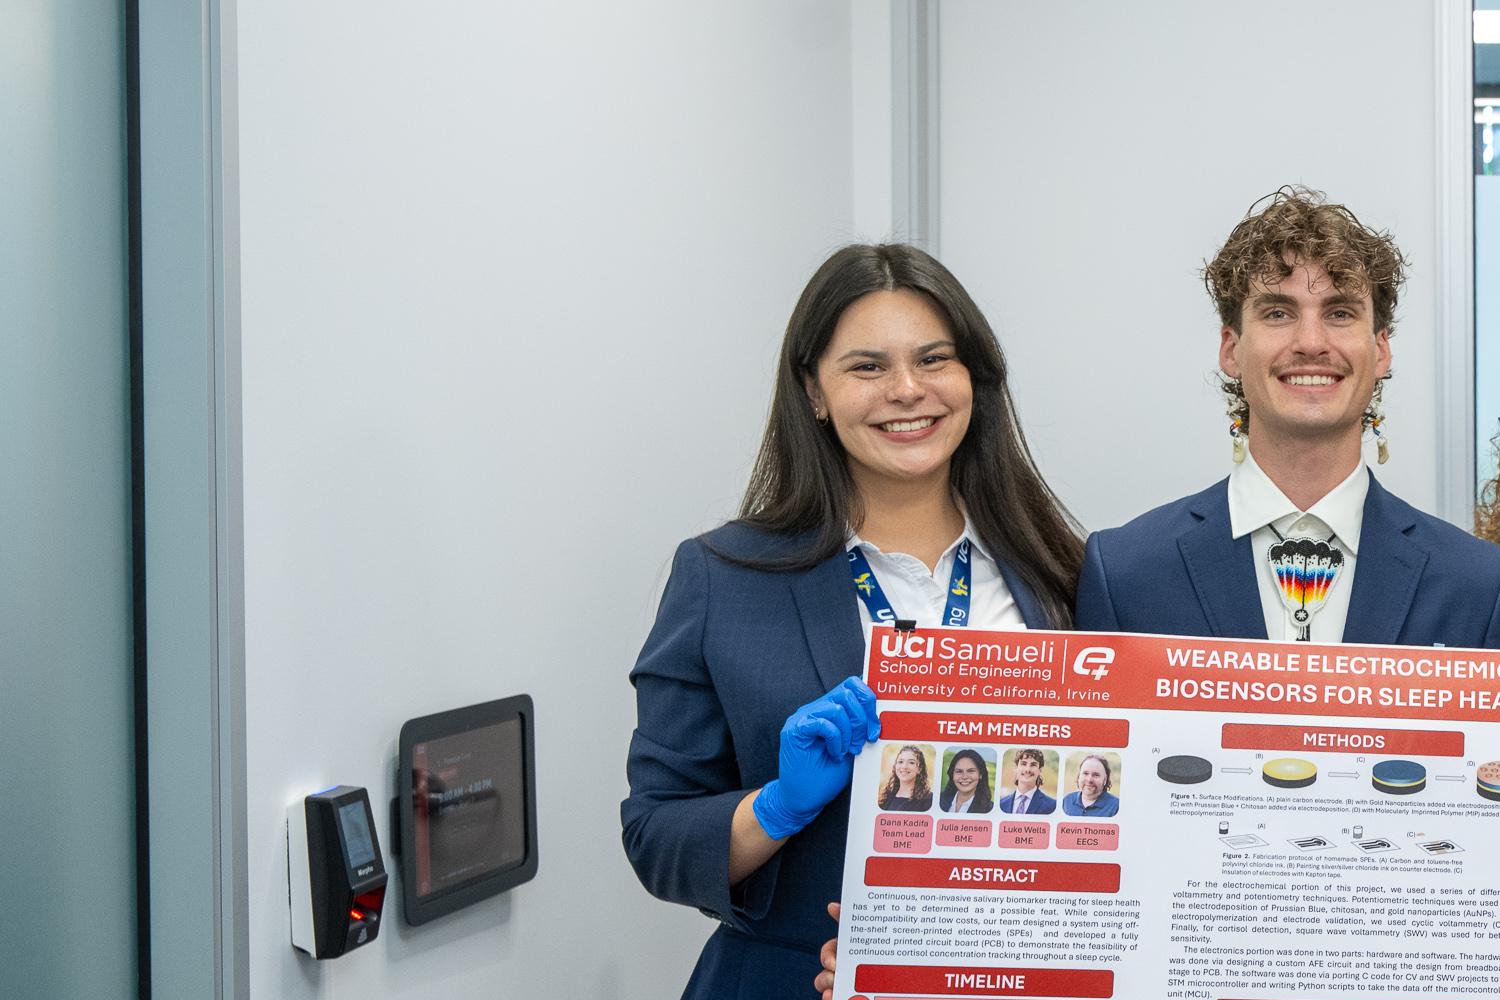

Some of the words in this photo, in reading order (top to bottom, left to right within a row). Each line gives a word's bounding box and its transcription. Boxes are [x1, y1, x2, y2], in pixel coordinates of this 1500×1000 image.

[880, 636, 934, 658] UCI
[938, 637, 1054, 663] Samueli
[1166, 647, 1300, 671] WEARABLE
[879, 660, 933, 674] School
[937, 662, 954, 675] of
[958, 663, 1051, 681] Engineering
[877, 681, 955, 697] University
[960, 684, 977, 696] of
[982, 685, 1060, 700] California,
[1067, 687, 1110, 701] Irvine
[1156, 678, 1317, 703] BIOSENSORS
[1323, 685, 1372, 705] FOR
[1378, 687, 1453, 707] SLEEP
[937, 720, 983, 735] TEAM
[987, 722, 1071, 738] MEMBERS
[1303, 732, 1385, 748] METHODS
[879, 818, 902, 826] Dana
[903, 819, 929, 827] Kadifa
[940, 823, 959, 832] Julia
[960, 824, 988, 832] Jensen
[1003, 825, 1022, 834] Luke
[1023, 826, 1046, 834] Wells
[881, 829, 903, 837] Team
[905, 830, 925, 838] Lead
[954, 834, 973, 843] BME
[1060, 827, 1083, 835] Kevin
[1084, 827, 1115, 836] Thomas
[892, 840, 912, 849] BME
[1014, 836, 1033, 844] BME
[1076, 837, 1099, 846] EECS
[948, 866, 1038, 883] ABSTRACT
[867, 891, 918, 902] Continuous,
[919, 894, 971, 902] non-invasive
[972, 895, 1004, 904] salivary
[1006, 895, 1047, 904] biomarker
[1048, 897, 1077, 907] tracing
[1078, 897, 1089, 906] for
[1091, 898, 1113, 907] sleep
[1115, 898, 1141, 907] health
[944, 973, 1025, 989] TIMELINE
